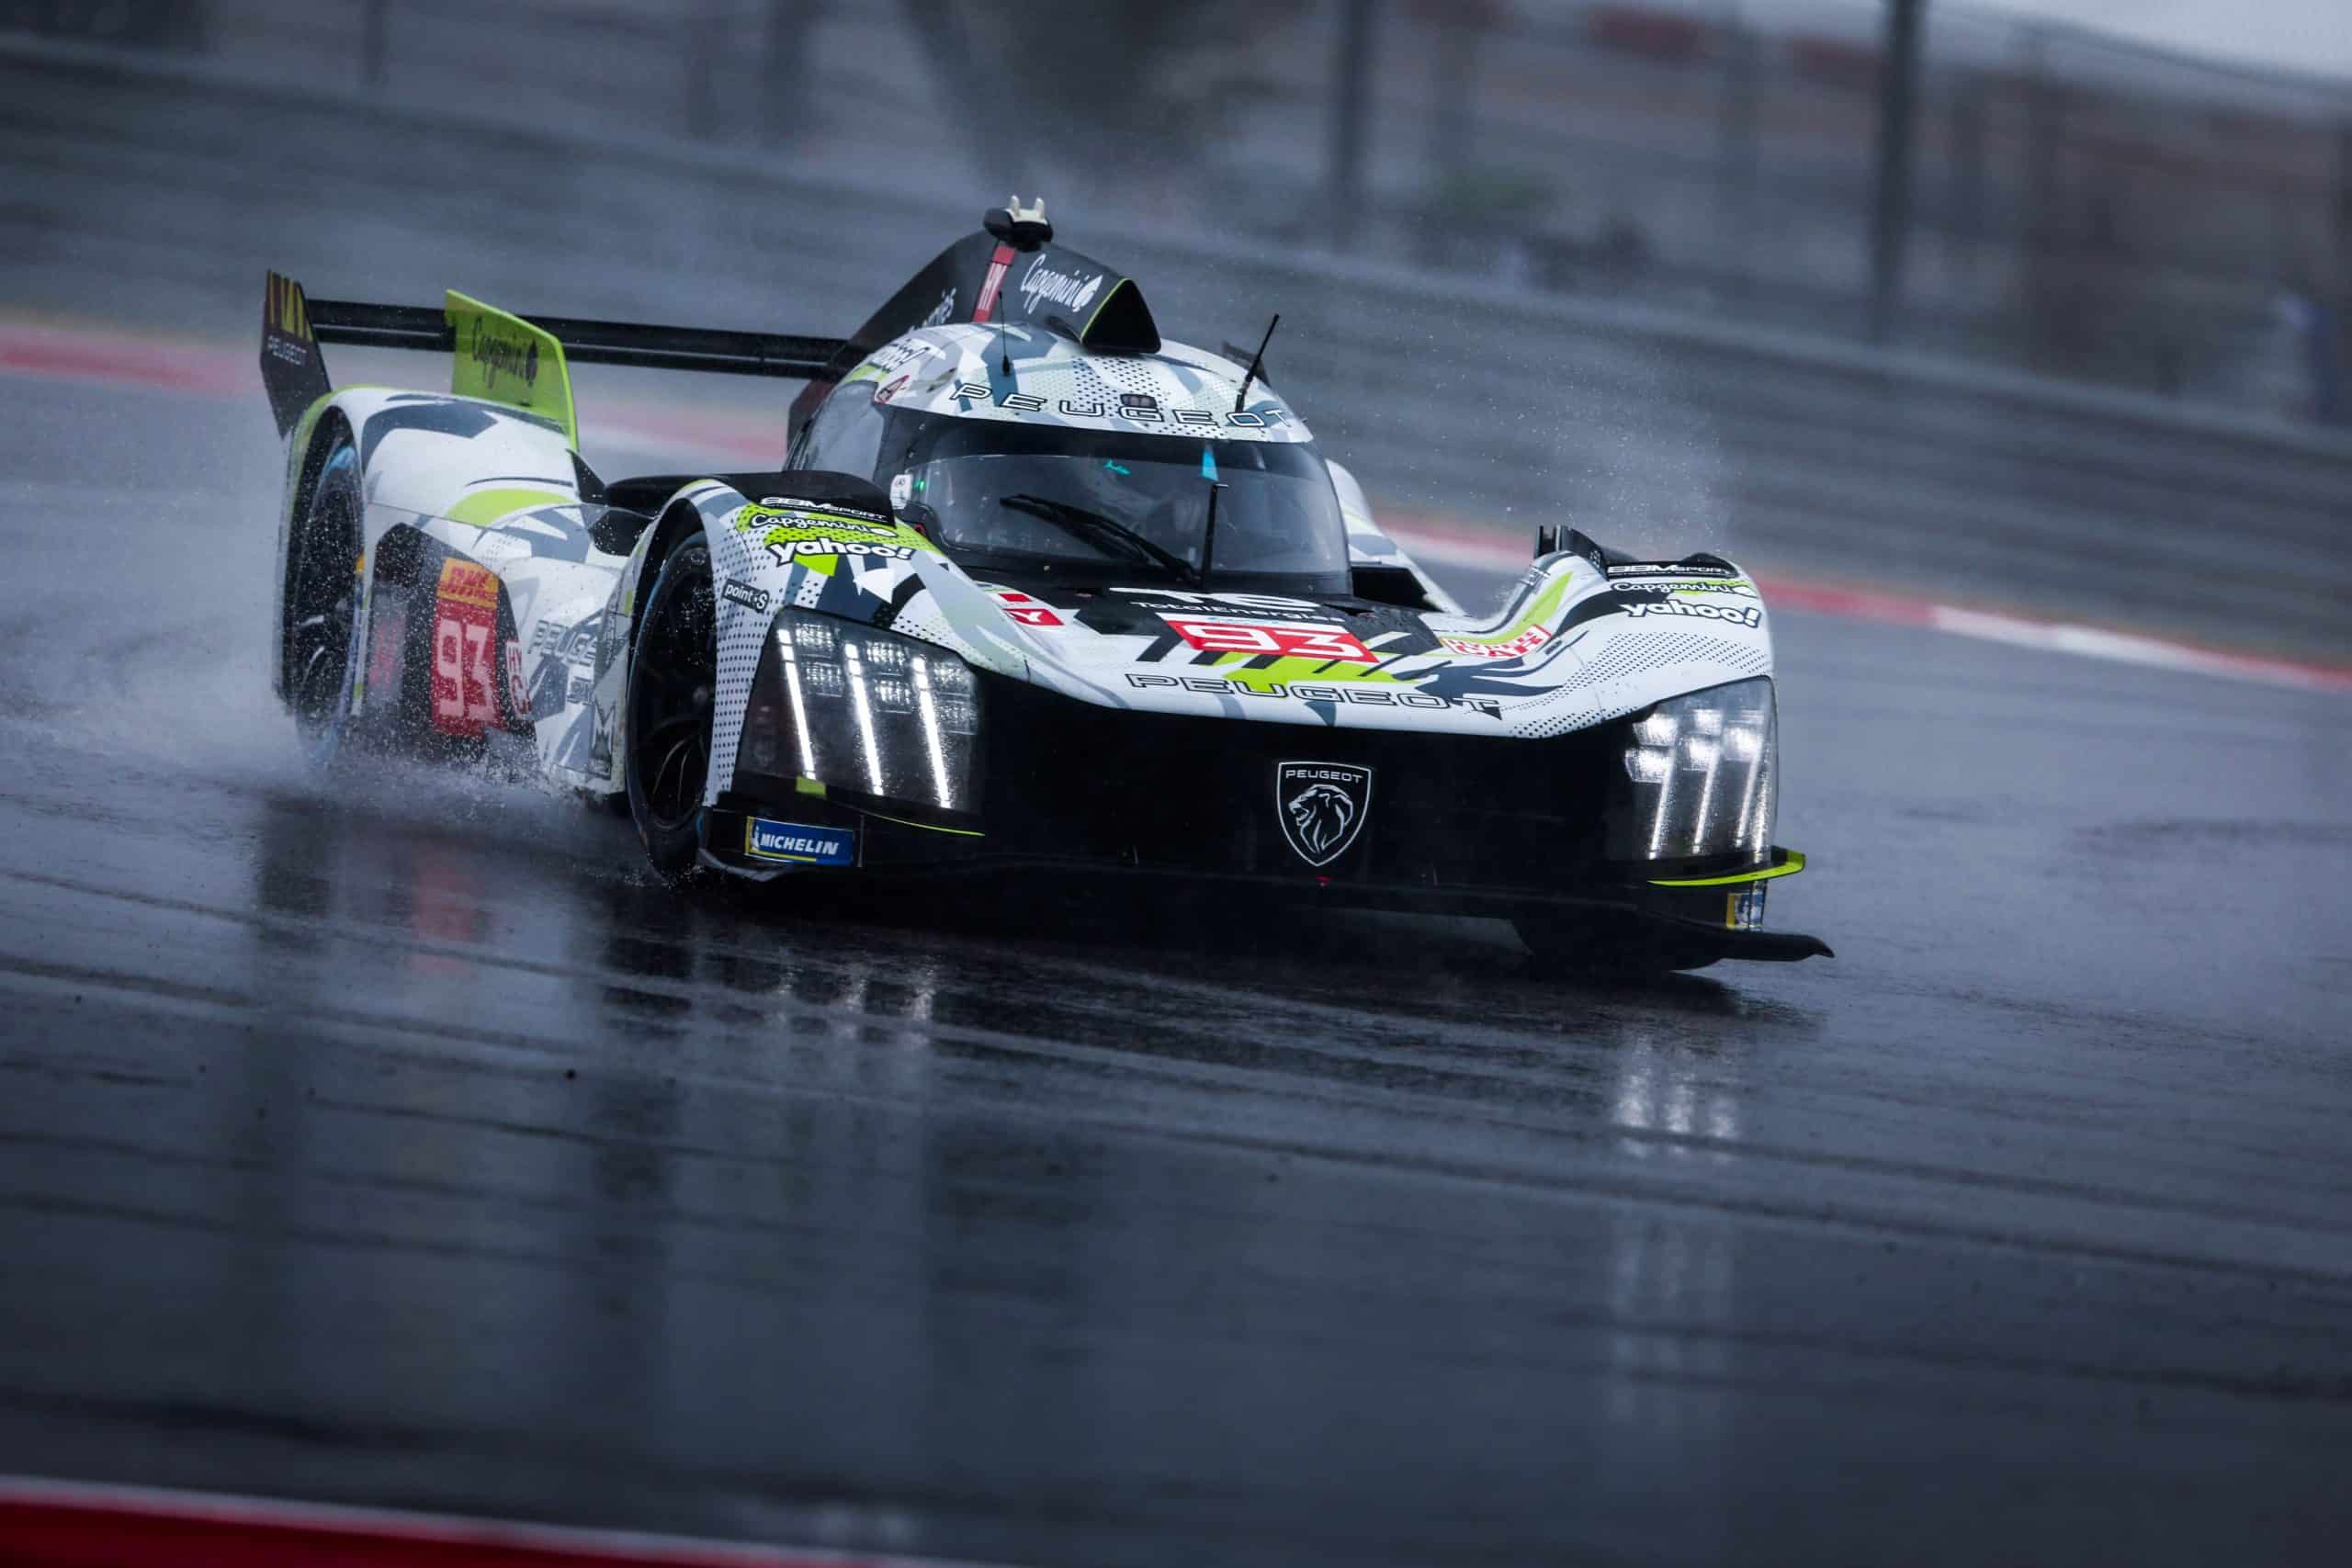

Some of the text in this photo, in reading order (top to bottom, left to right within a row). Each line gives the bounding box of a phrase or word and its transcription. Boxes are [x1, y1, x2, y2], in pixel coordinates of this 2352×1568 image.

[1020, 253, 1090, 315] Capgemini
[949, 382, 1295, 430] PEUGEOT
[750, 513, 870, 533] Capgemini
[766, 536, 917, 567] yahoo!
[1611, 582, 1731, 593] Capgemini
[1130, 602, 1346, 623] TotalEnergies
[1620, 599, 1761, 628] yahoo!
[1182, 625, 1365, 657] 93
[439, 617, 494, 722] 93
[1125, 672, 1500, 712] PEUGEOT
[1285, 769, 1363, 784] PEUGEOT
[760, 832, 840, 855] MICHELIN
